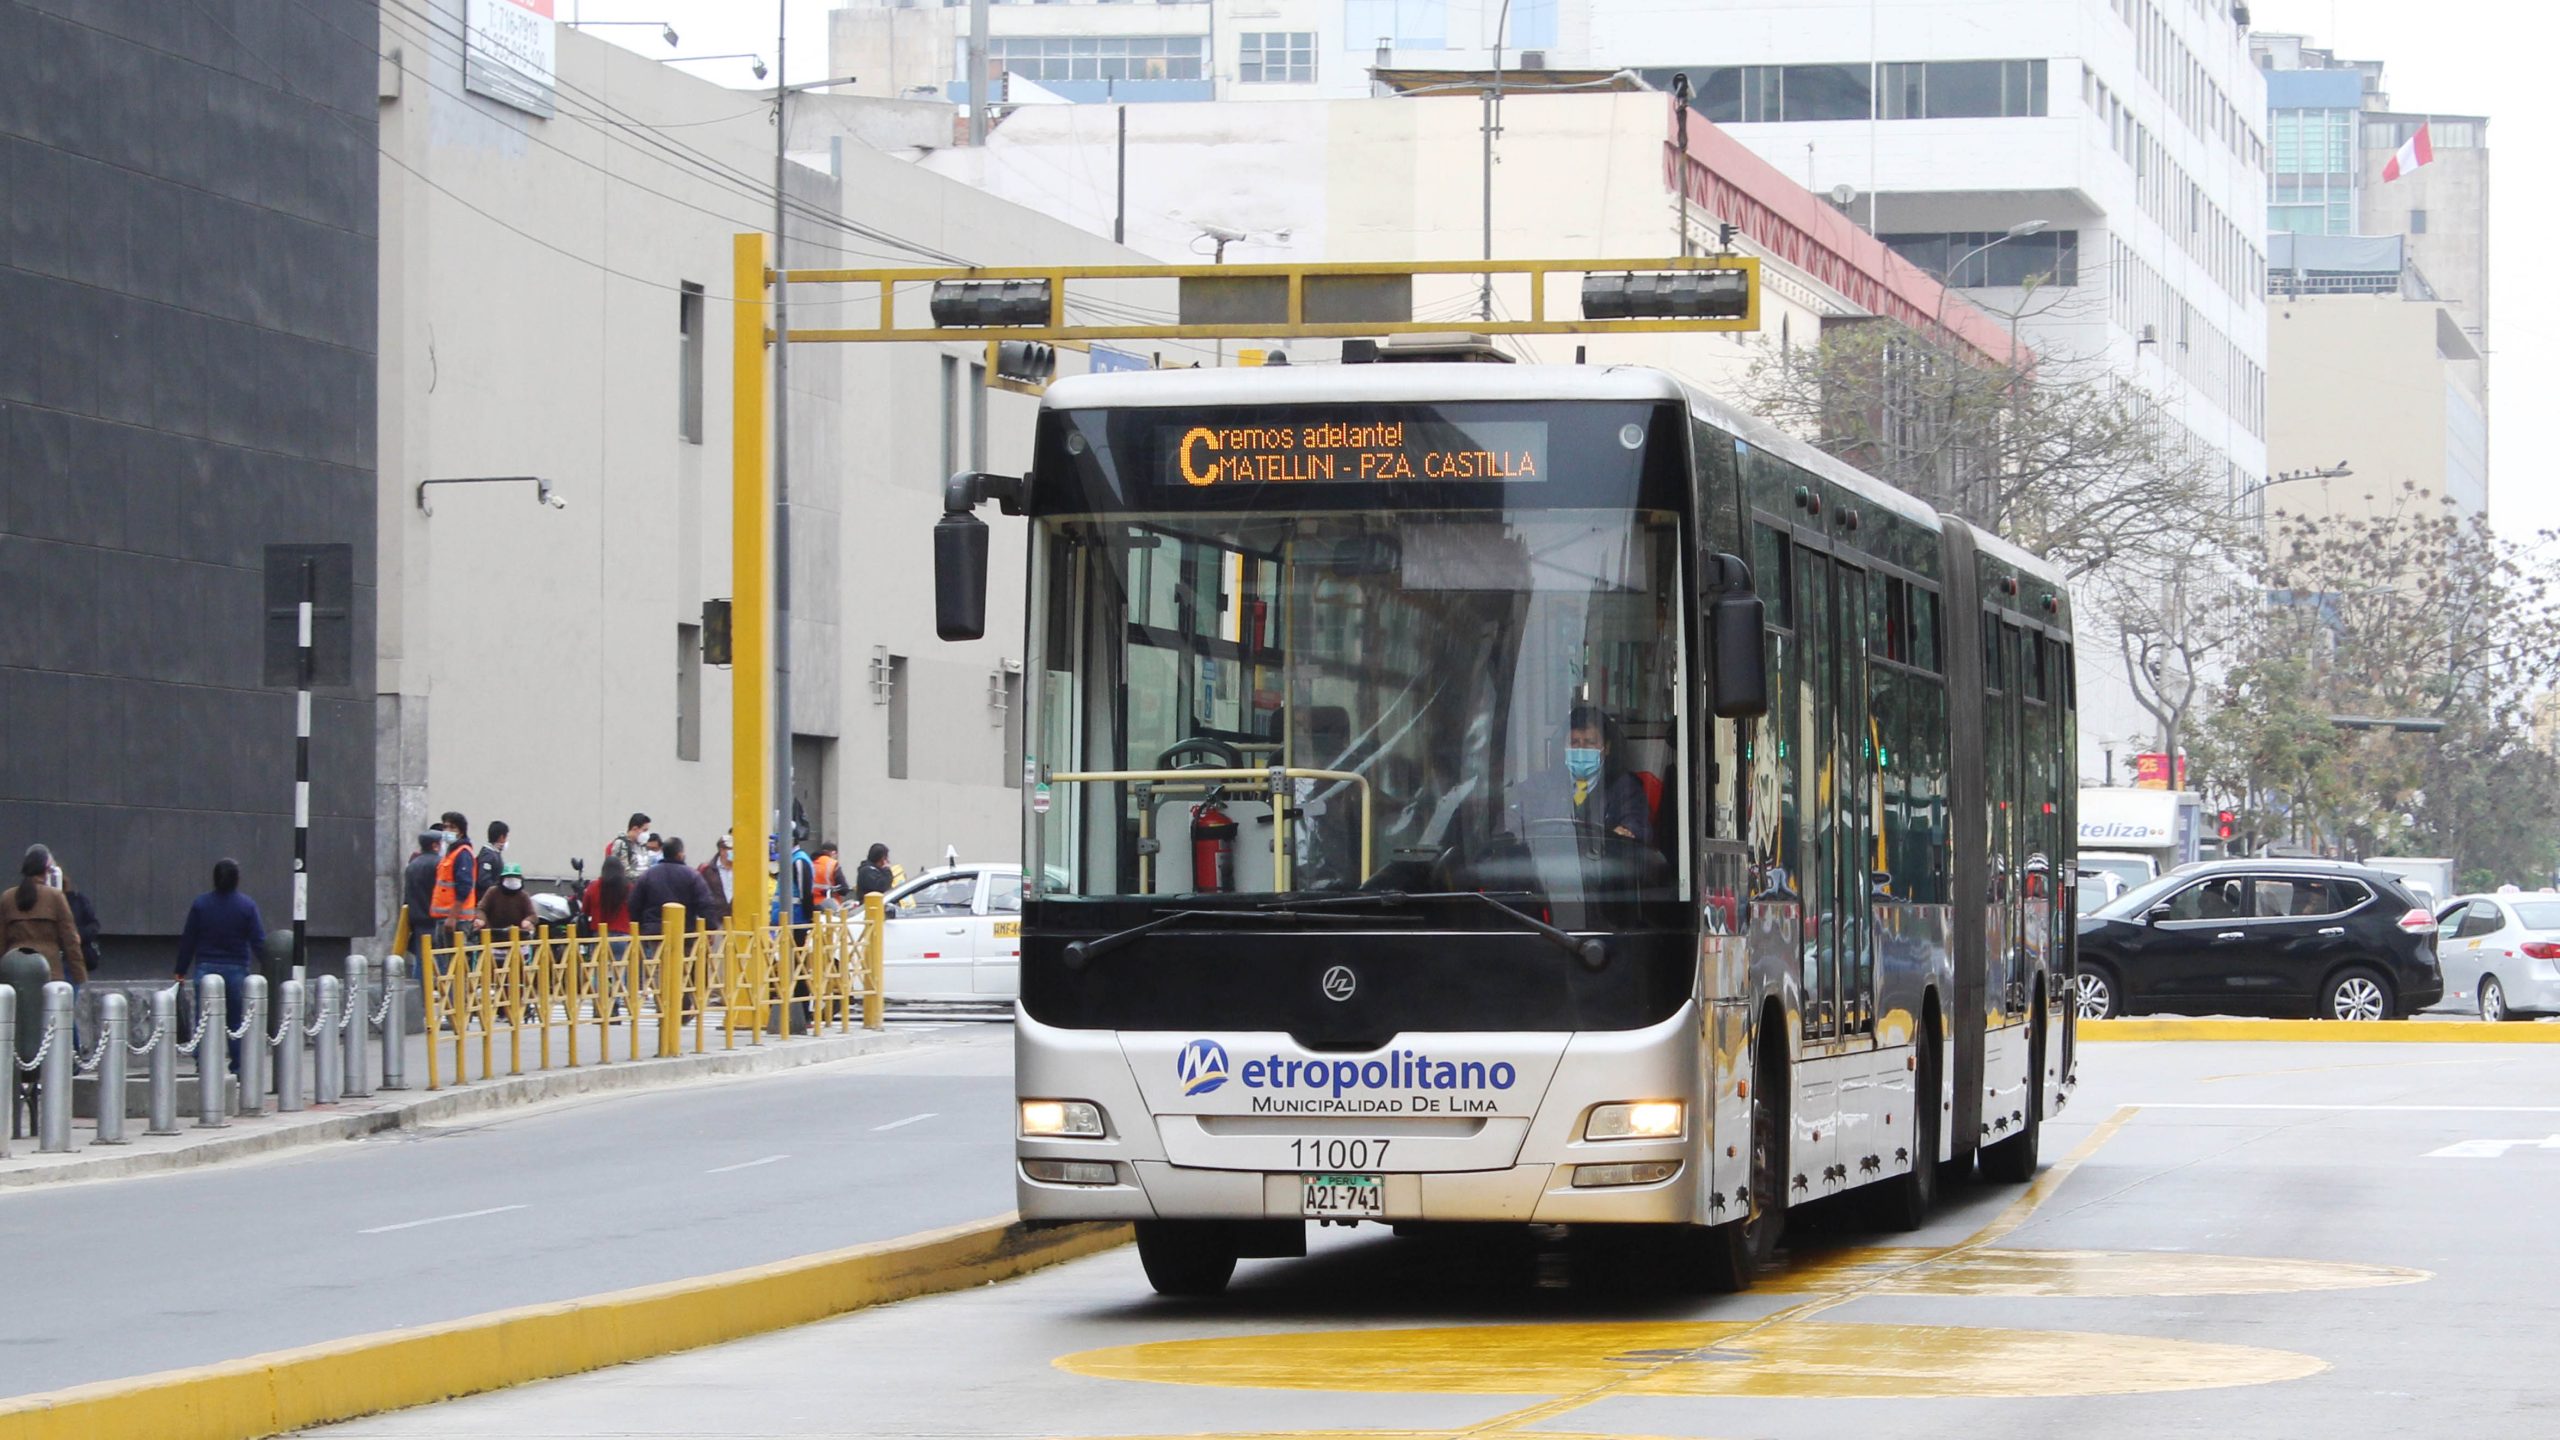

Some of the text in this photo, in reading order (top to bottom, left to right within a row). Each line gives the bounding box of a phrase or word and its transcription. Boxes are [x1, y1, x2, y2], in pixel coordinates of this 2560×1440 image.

[1303, 423, 1402, 449] adelante!
[1219, 454, 1334, 481] MATELLINI
[1360, 453, 1416, 480] PZA.
[1424, 451, 1536, 478] CASTILLA
[2078, 822, 2149, 838] teliza
[1252, 1096, 1403, 1112] MUNICIPALIDAD
[1449, 1096, 1499, 1112] LIMA
[1290, 1139, 1391, 1169] 11007
